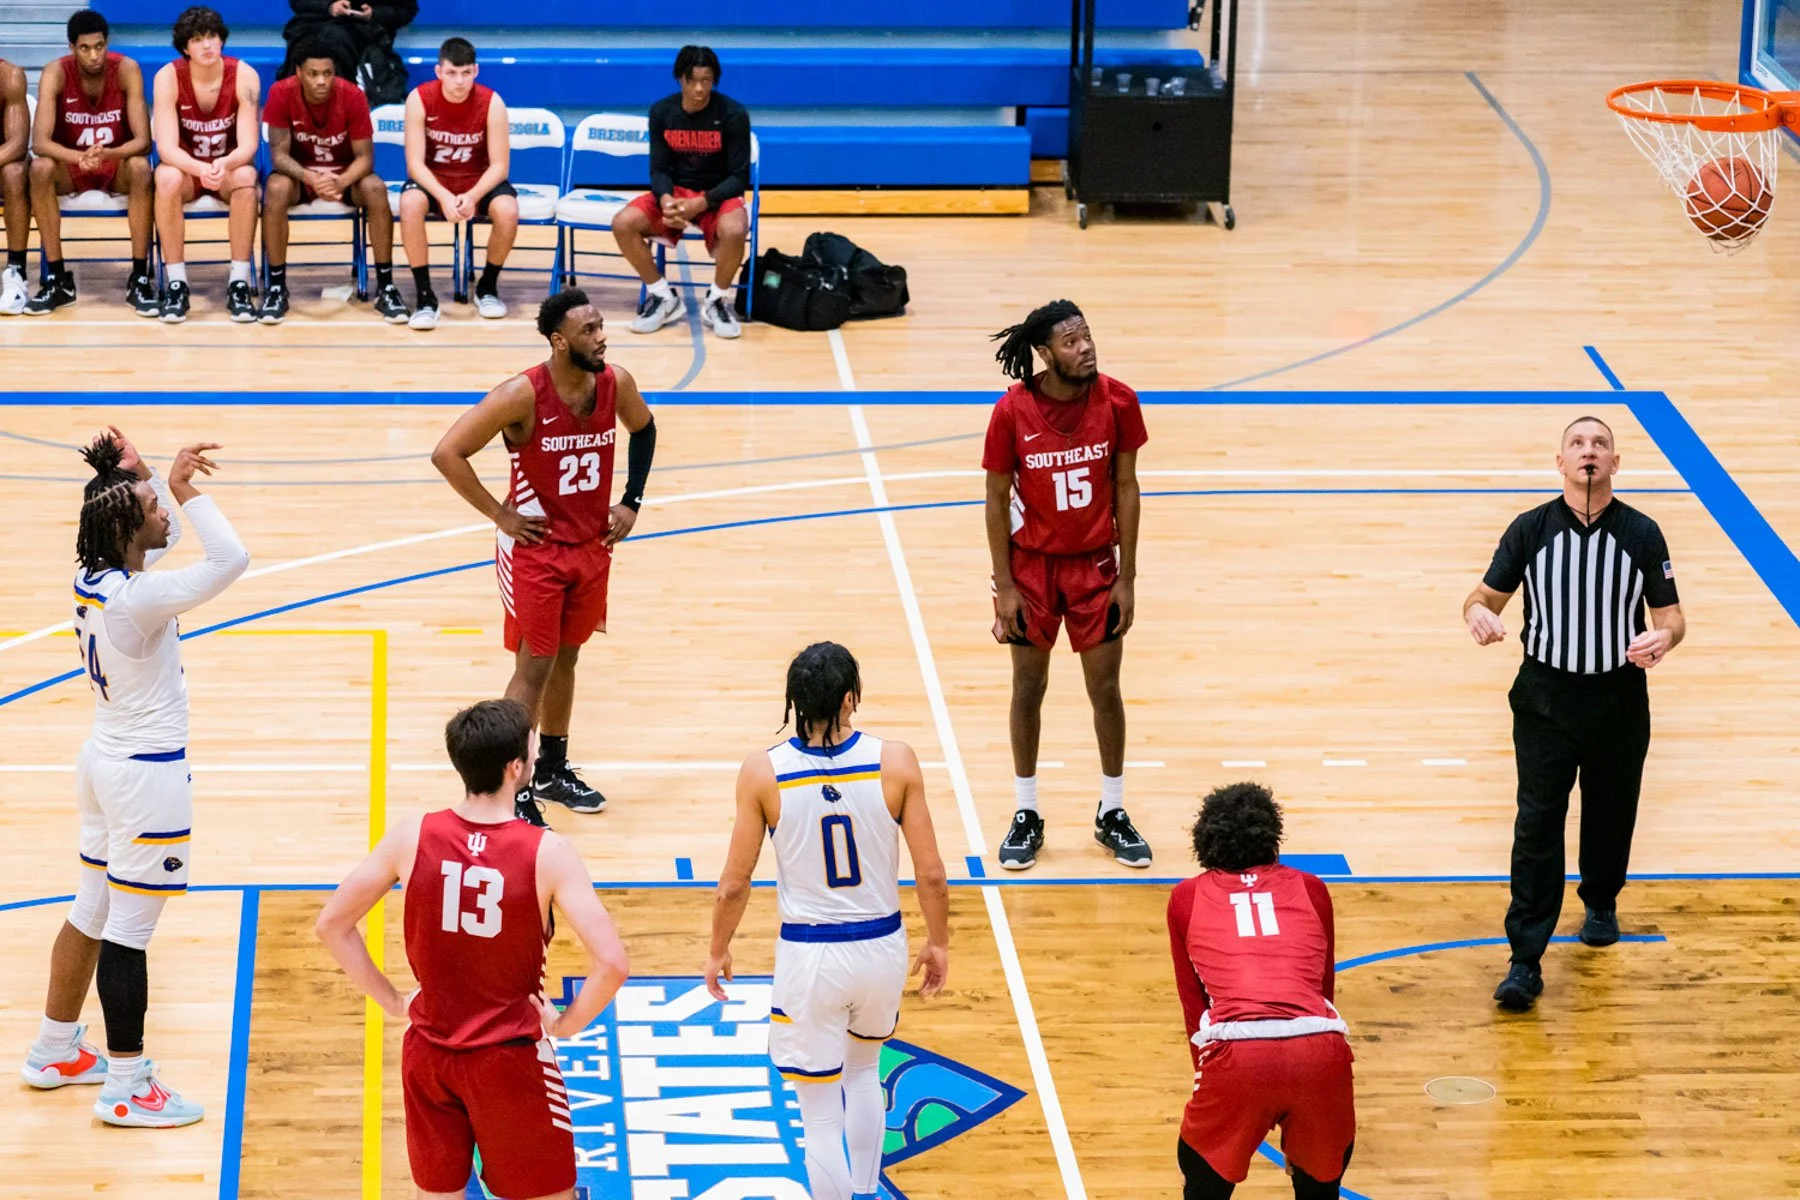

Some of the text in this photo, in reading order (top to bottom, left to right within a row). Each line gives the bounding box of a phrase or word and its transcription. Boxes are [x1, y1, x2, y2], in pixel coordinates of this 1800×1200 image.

[65, 109, 121, 124] SOUTHEAST
[76, 127, 114, 147] 42
[192, 133, 227, 156] 33
[314, 145, 334, 162] 5
[433, 145, 472, 163] 24
[541, 428, 616, 452] SOUTHEAST
[1025, 440, 1109, 469] SOUTHEAST
[559, 452, 600, 496] 23
[1052, 467, 1093, 511] 15
[820, 814, 862, 889] 0
[441, 860, 504, 938] 13
[1229, 891, 1280, 937] 11
